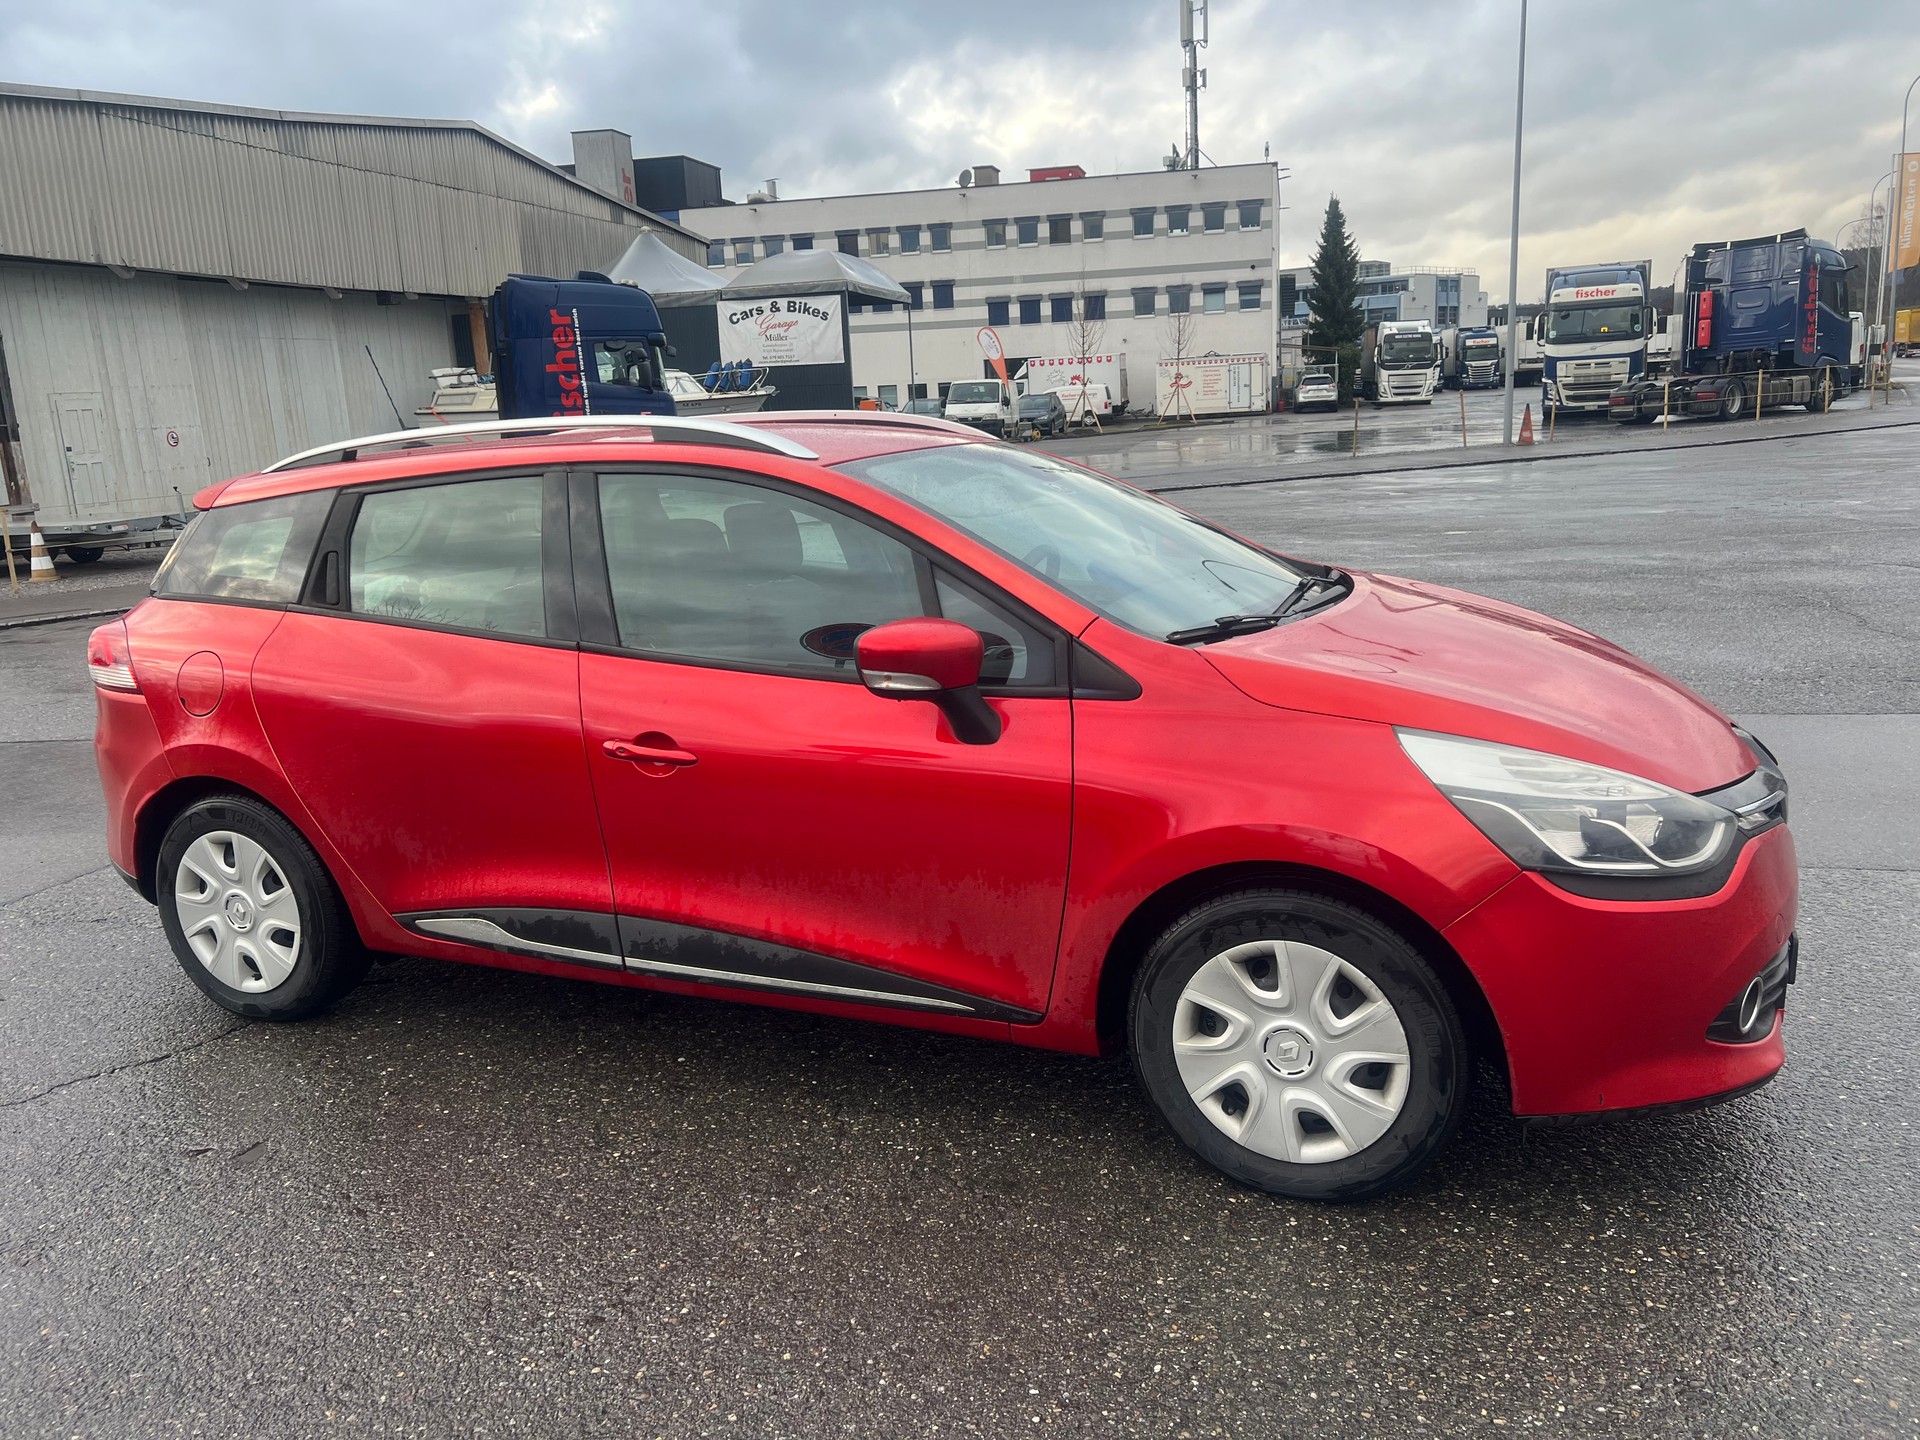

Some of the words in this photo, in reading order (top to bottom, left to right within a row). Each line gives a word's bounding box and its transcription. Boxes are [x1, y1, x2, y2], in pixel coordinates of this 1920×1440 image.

[1575, 288, 1617, 299] fischer
[571, 308, 580, 328] zurich
[728, 305, 765, 325] Cars
[769, 300, 781, 313] &
[786, 300, 830, 321] Bikes
[1802, 263, 1818, 353] fischer
[754, 313, 799, 336] Garage
[574, 328, 582, 346] basel
[764, 334, 789, 342] Müller
[545, 308, 583, 417] ischer
[577, 346, 585, 371] warsaw
[580, 372, 589, 399] frankfurt
